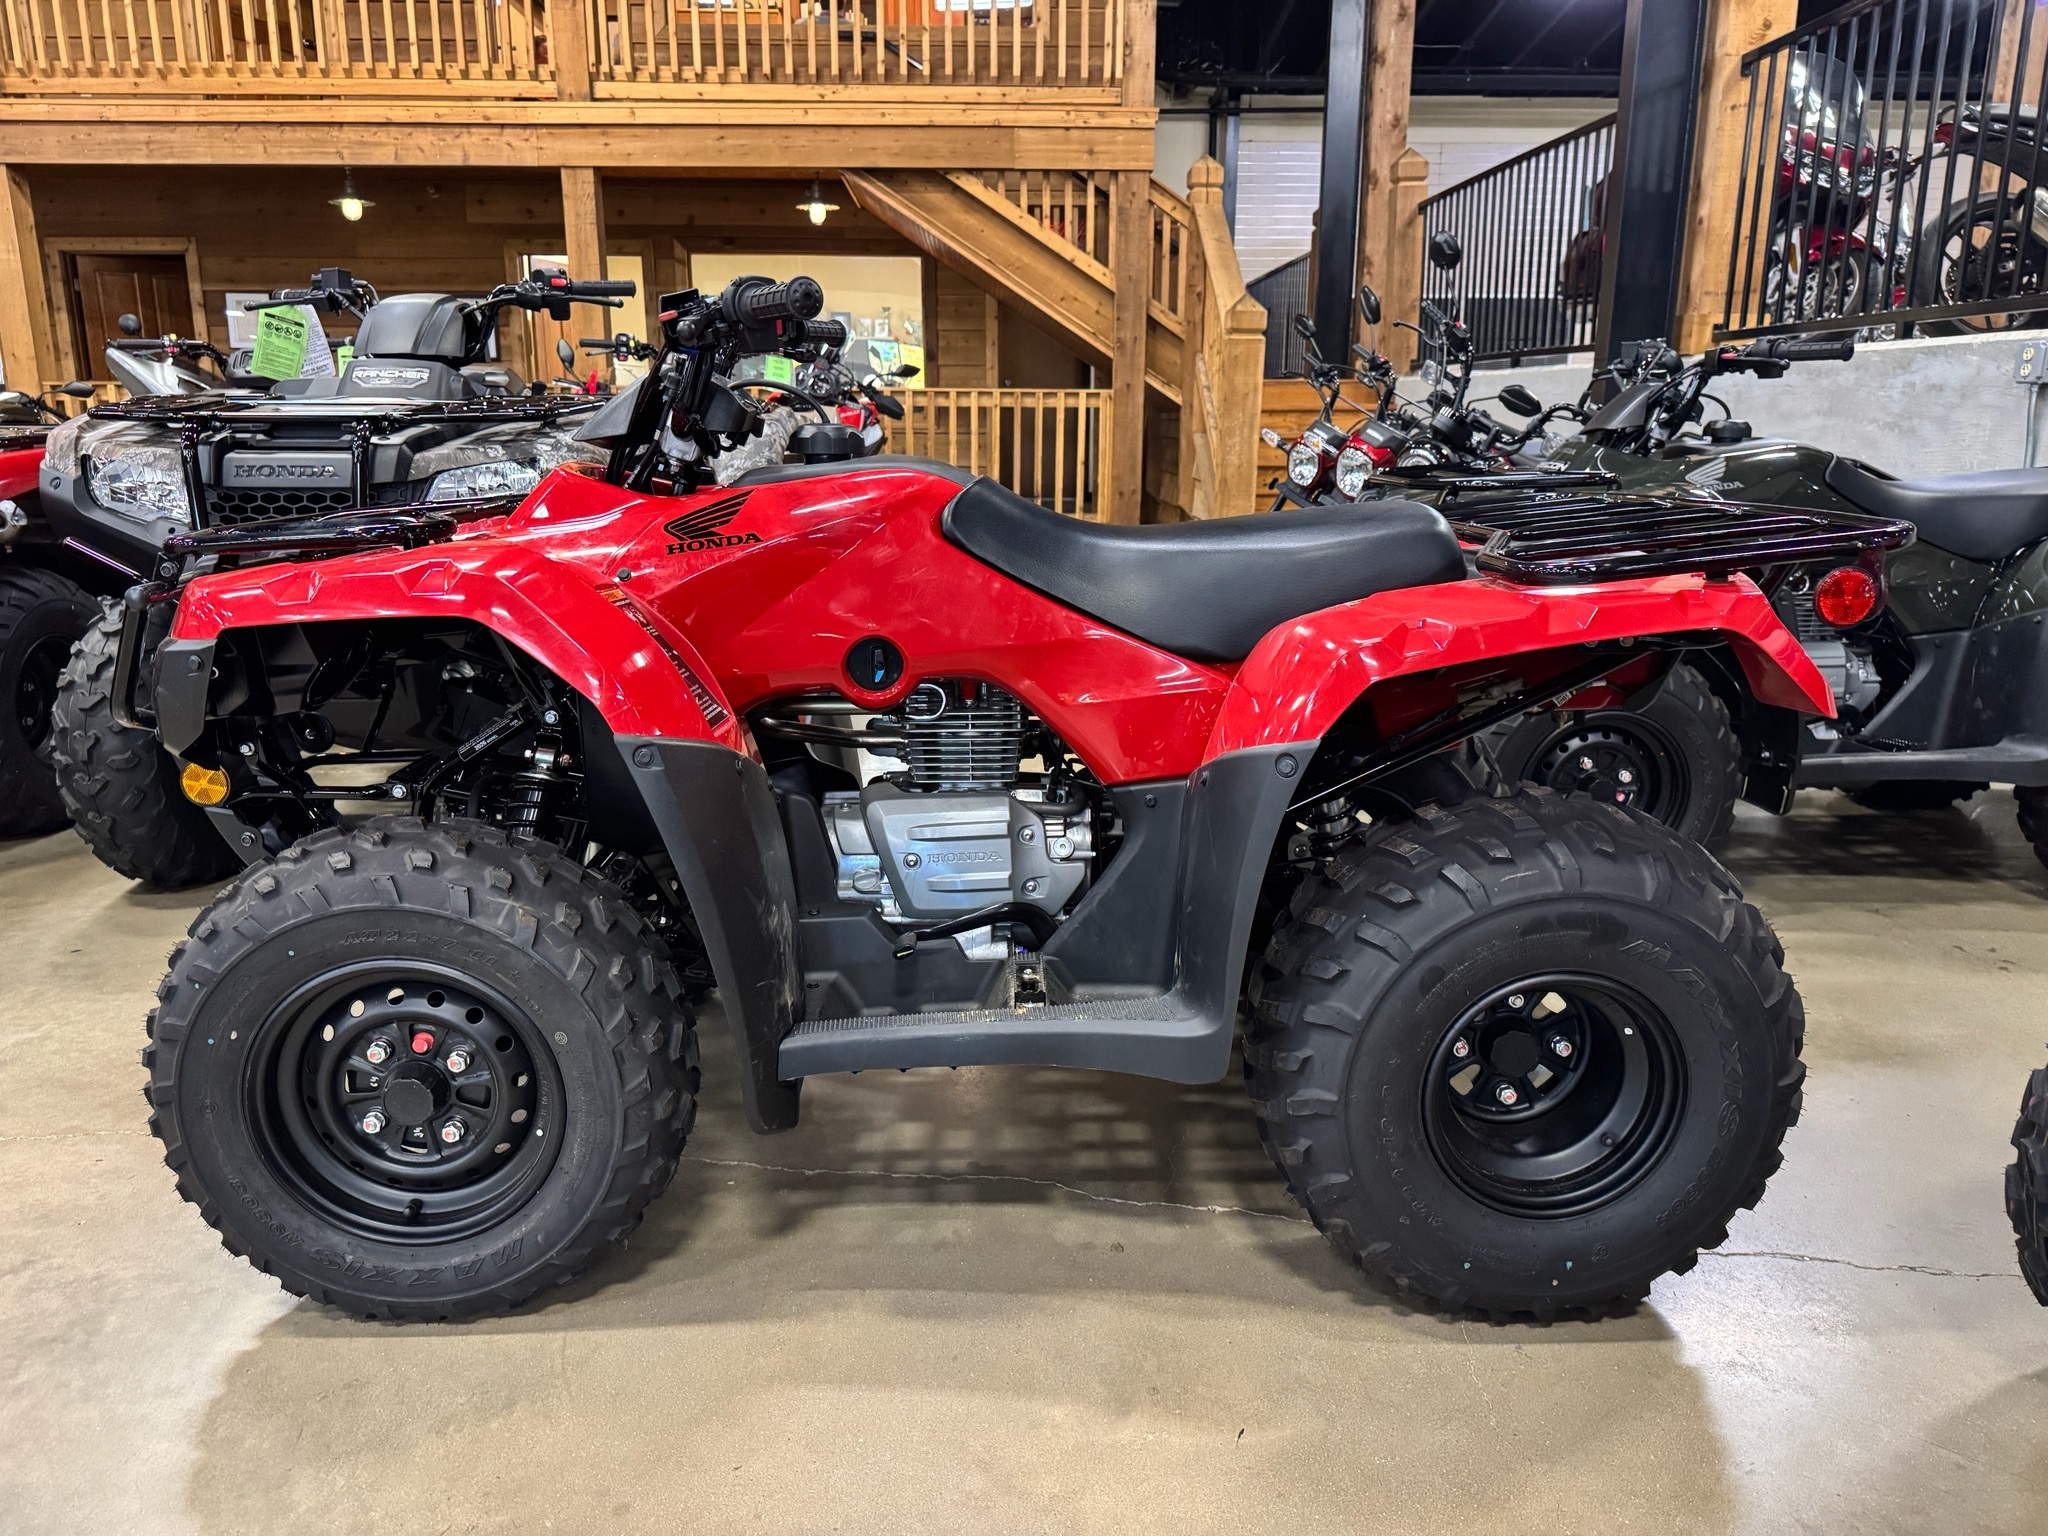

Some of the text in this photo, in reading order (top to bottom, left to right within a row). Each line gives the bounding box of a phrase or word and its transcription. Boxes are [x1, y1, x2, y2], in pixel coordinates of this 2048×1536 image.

[352, 370, 430, 380] RANCHER
[233, 464, 341, 478] HONDA
[1702, 481, 1745, 491] ONDA
[665, 532, 764, 556] HONDA
[926, 850, 1004, 865] HONDA
[1619, 939, 1744, 1139] MAXXIS
[309, 1235, 525, 1286] MAXXIS
